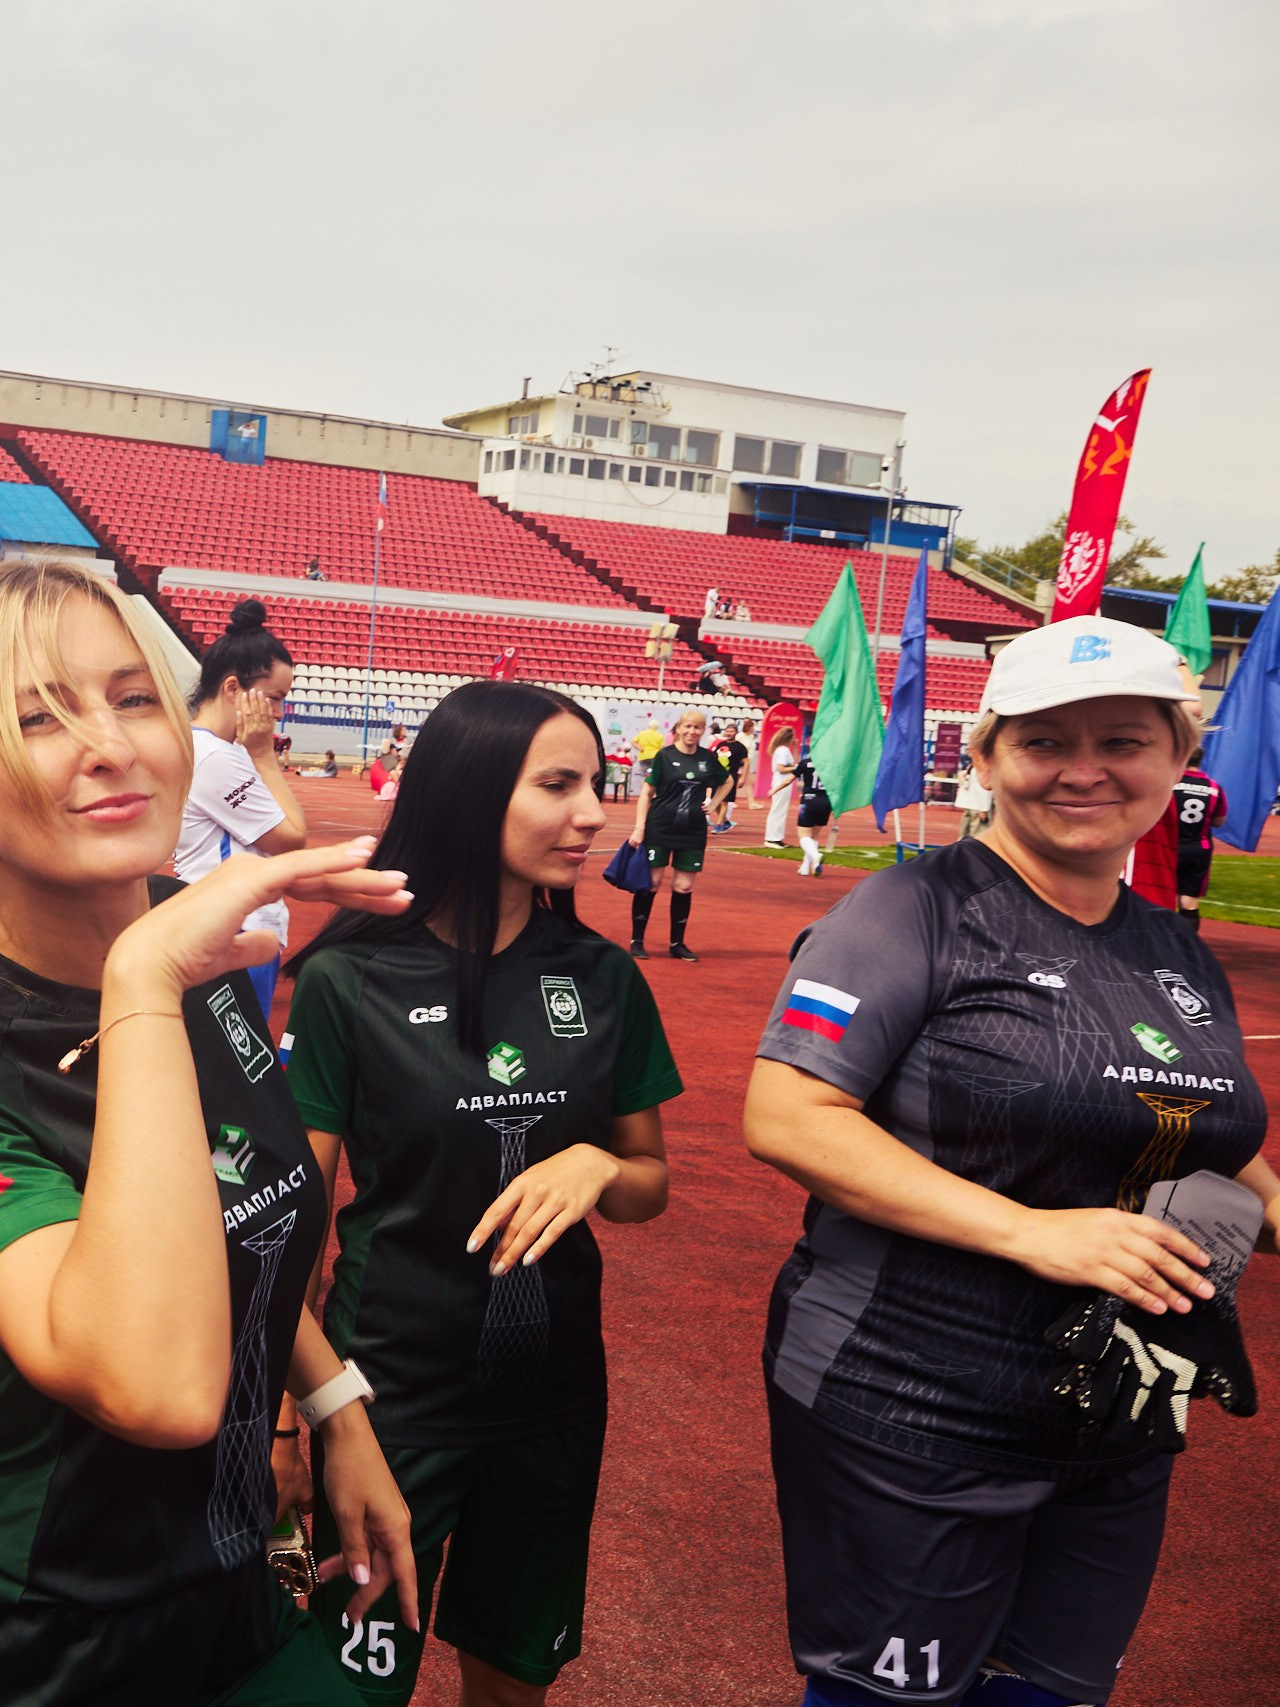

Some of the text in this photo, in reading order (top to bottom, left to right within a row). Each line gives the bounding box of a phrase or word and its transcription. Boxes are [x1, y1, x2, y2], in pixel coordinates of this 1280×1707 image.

[1180, 798, 1206, 824] 8
[1027, 972, 1067, 989] GS
[408, 1005, 448, 1024] GS
[1102, 1064, 1235, 1093] АДВАПЛАСТ
[455, 1090, 568, 1111] АДВАПЛАСТ
[223, 1163, 307, 1234] ДВАПЛАСТ
[341, 1611, 396, 1677] 25
[872, 1636, 940, 1689] 41
